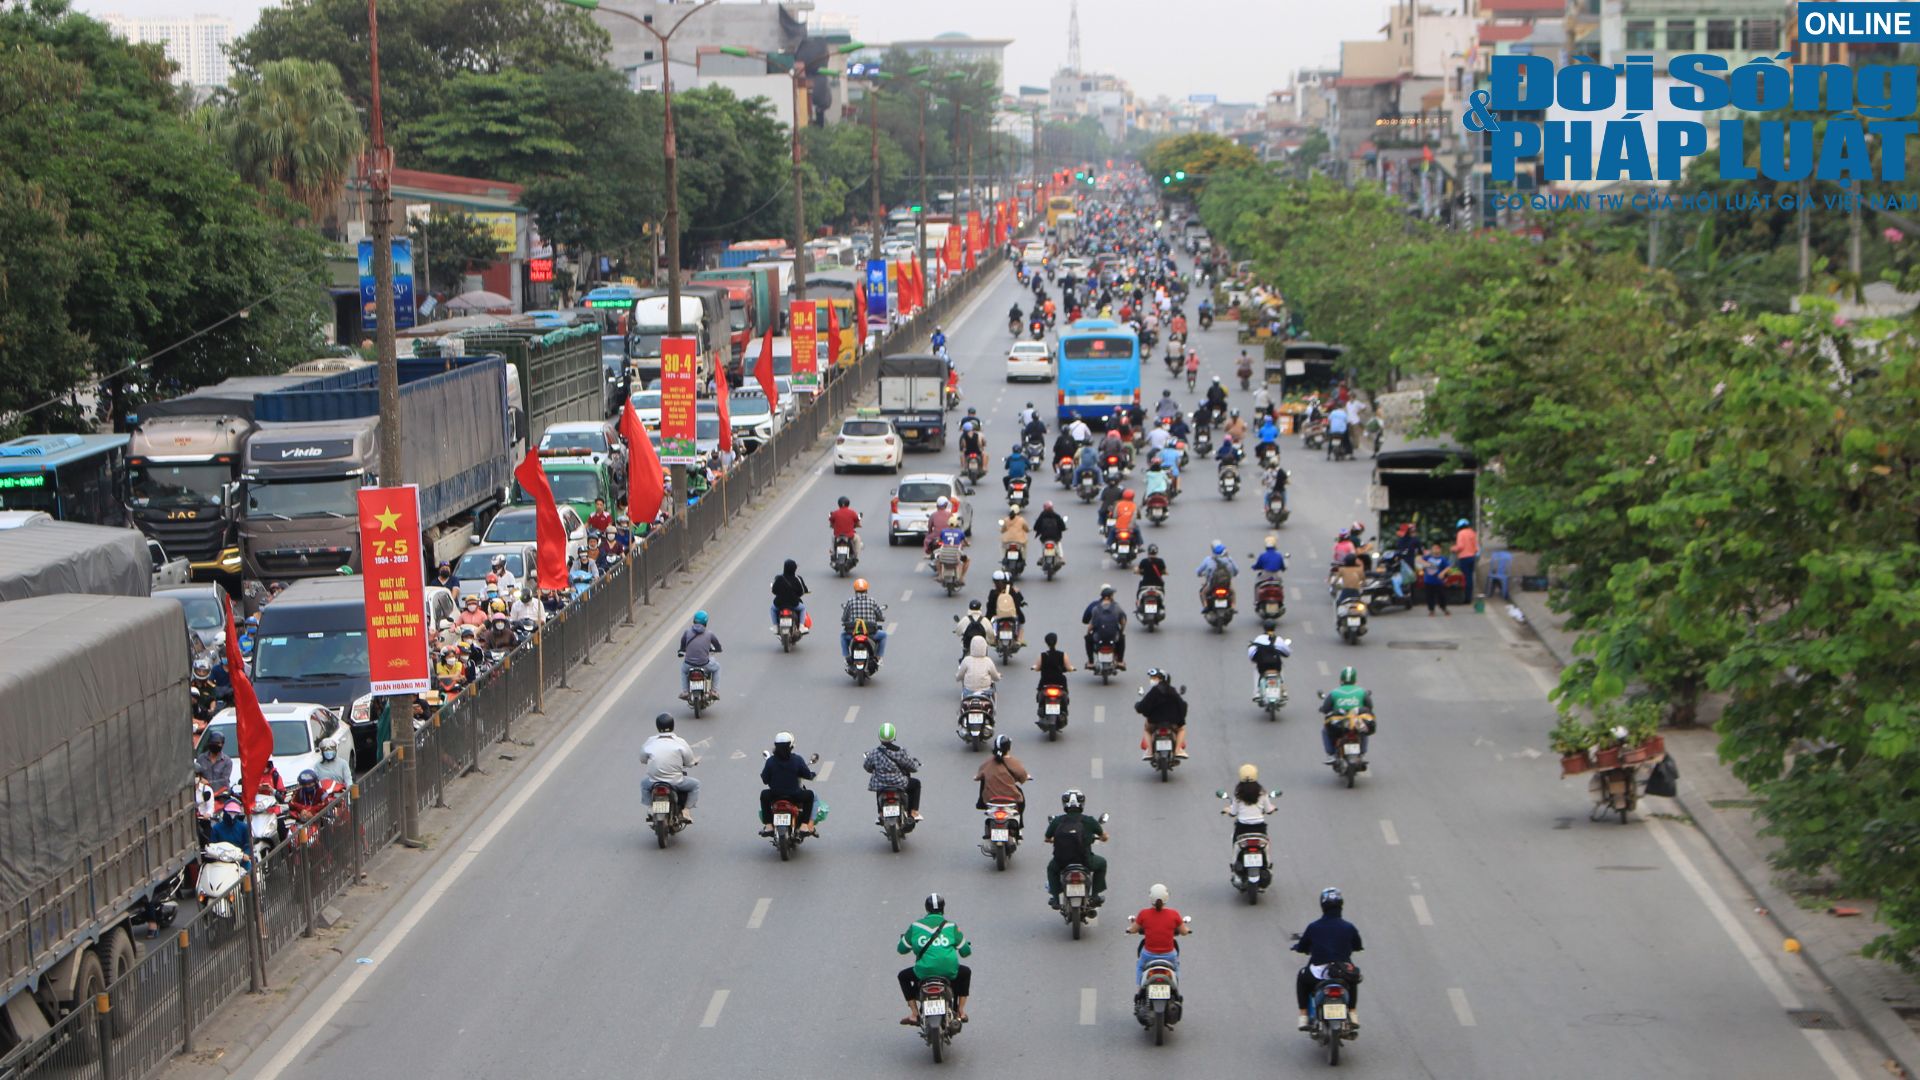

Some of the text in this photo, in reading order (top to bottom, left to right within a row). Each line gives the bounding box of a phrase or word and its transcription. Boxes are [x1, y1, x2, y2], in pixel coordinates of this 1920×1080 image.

[167, 511, 197, 519] JAC
[414, 681, 427, 689] MAI
[917, 933, 950, 947] Gab
